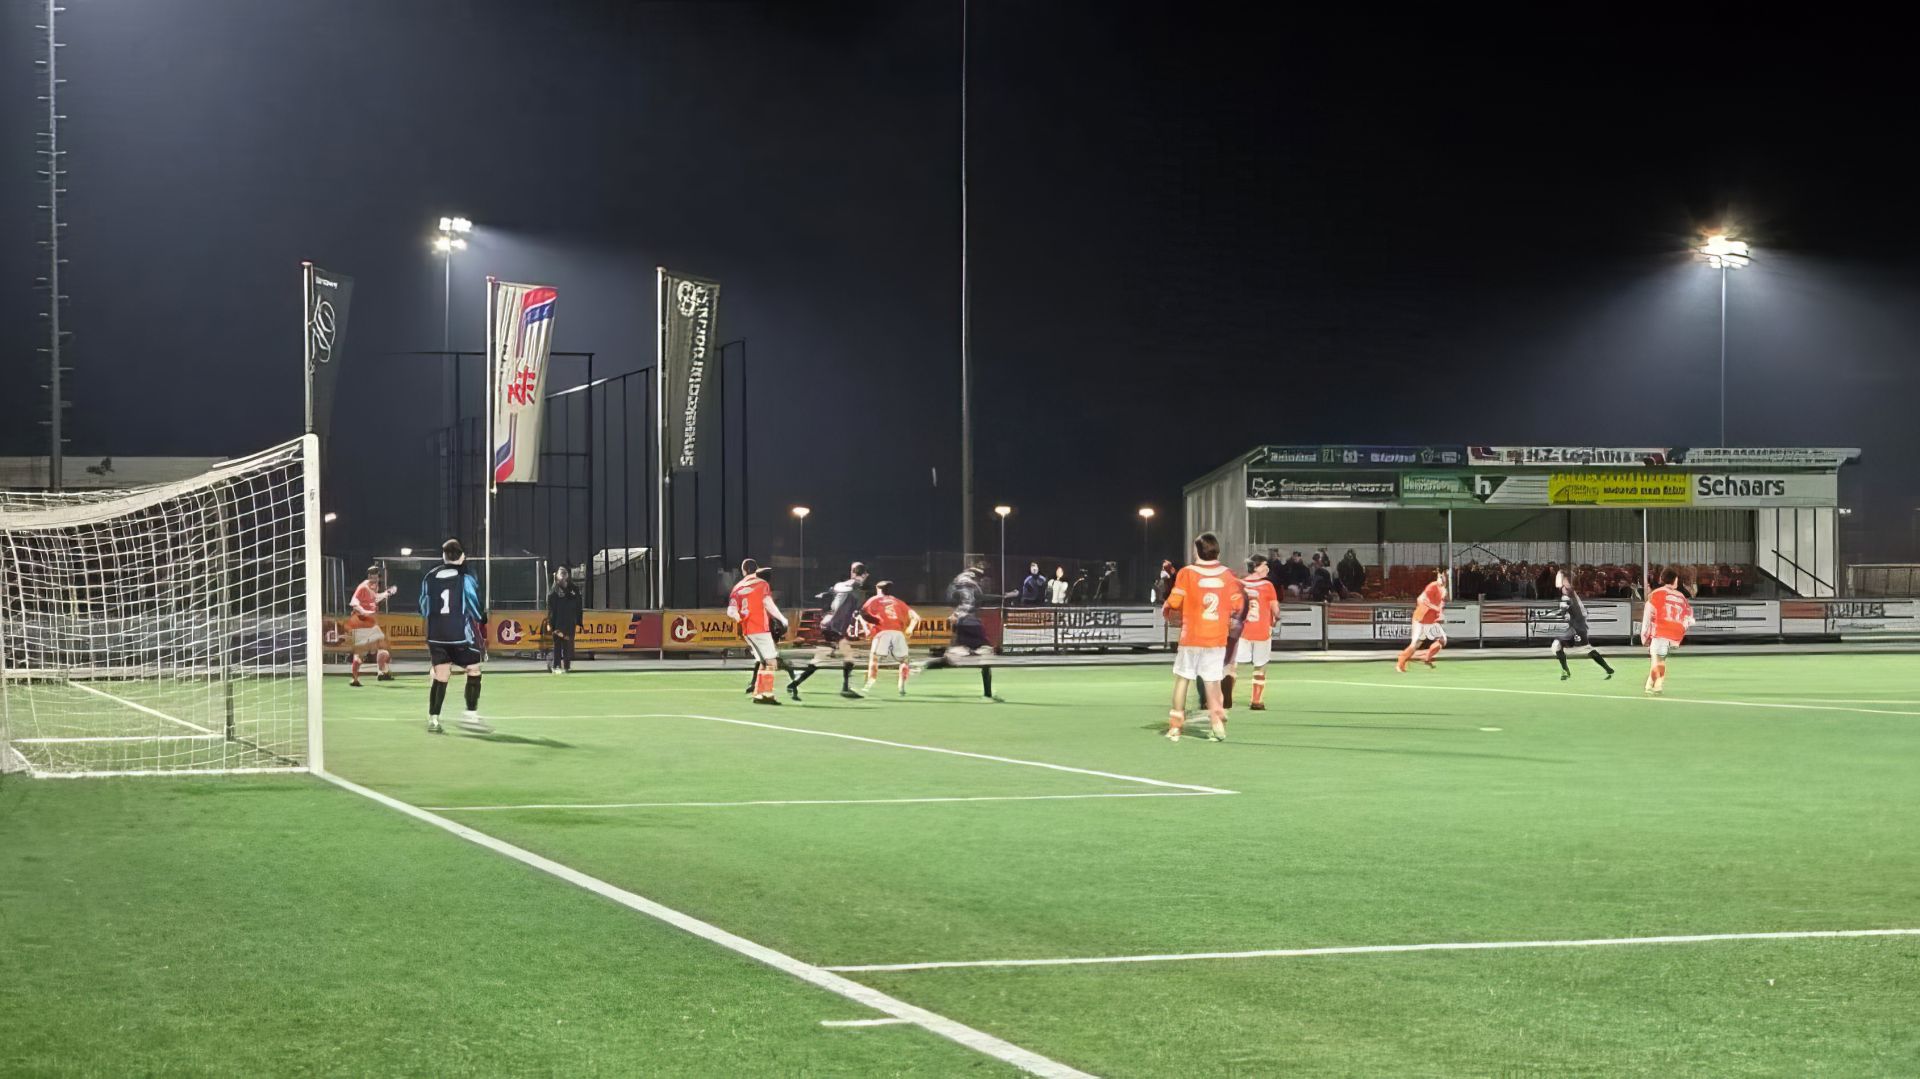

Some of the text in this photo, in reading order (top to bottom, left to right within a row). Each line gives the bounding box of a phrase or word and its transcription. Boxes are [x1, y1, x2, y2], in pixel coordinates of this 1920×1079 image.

[1698, 475, 1785, 496] Schaars
[440, 588, 450, 614] 1
[1202, 592, 1220, 621] 2
